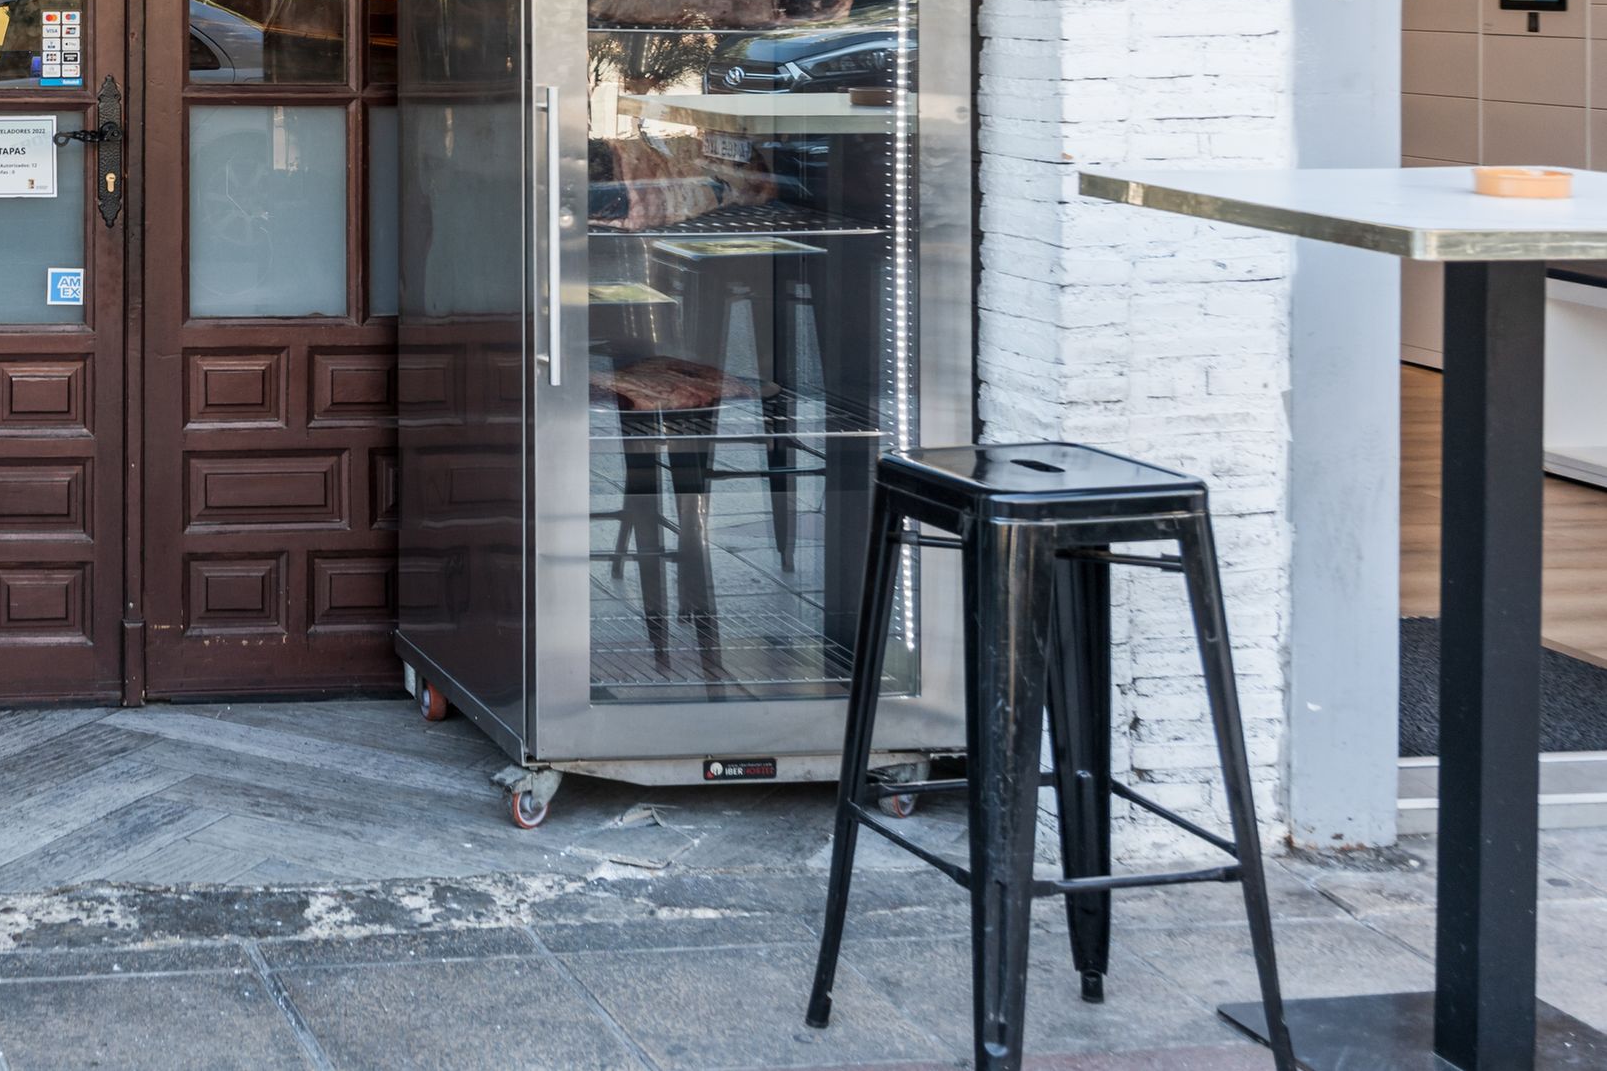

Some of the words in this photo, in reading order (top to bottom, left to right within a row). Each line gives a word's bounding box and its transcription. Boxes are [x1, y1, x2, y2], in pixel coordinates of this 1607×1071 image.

[57, 276, 80, 288] AM
[60, 287, 80, 299] EX
[724, 767, 744, 776] IBER
